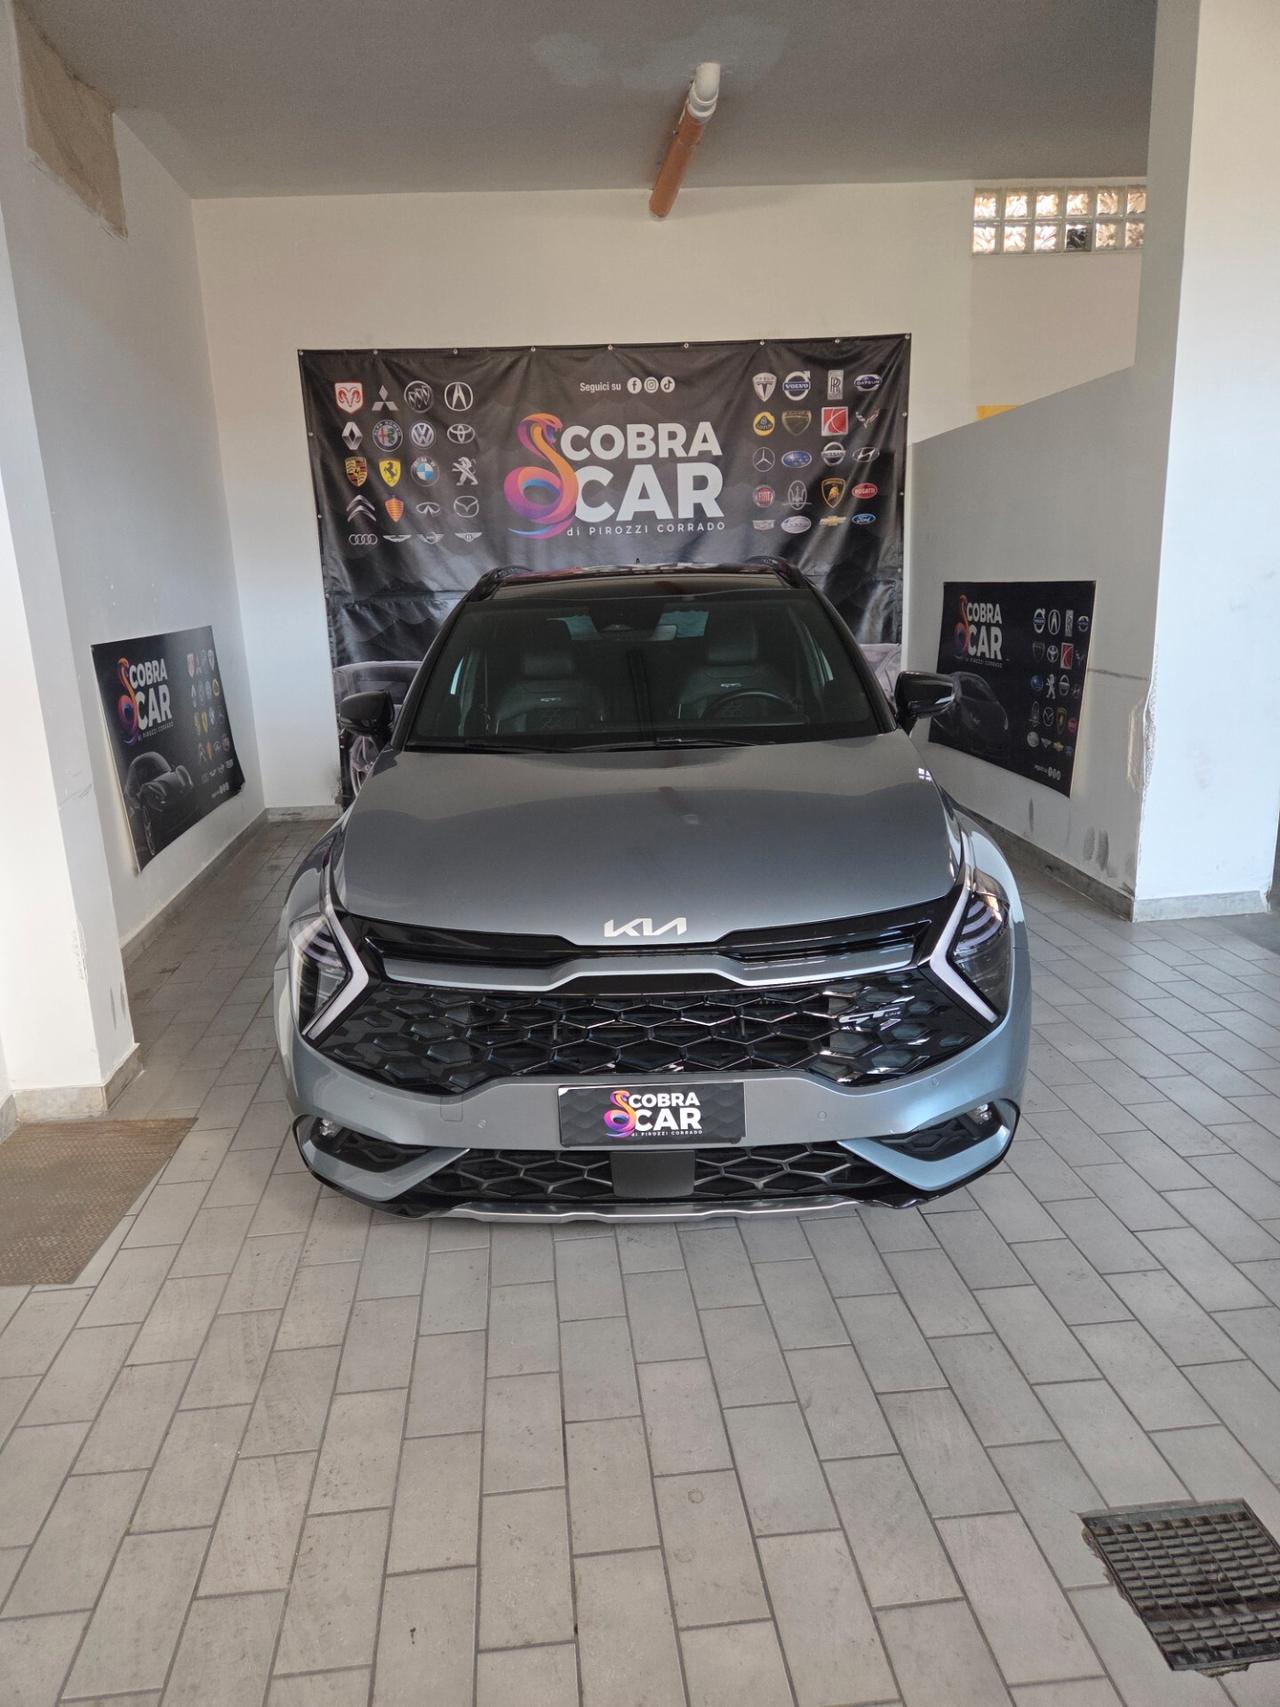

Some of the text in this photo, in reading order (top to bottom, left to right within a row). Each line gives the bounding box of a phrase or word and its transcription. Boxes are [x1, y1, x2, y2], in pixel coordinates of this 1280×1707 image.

[579, 381, 622, 393] Seguici su
[560, 421, 723, 461] COBRA
[575, 462, 725, 523] CAR
[566, 521, 725, 536] di PIROZZI CORRADO
[966, 602, 1003, 625] COBRA
[968, 624, 1003, 661] CAR
[129, 658, 168, 689] COBRA
[135, 684, 173, 731] CAR
[604, 917, 687, 937] KIA
[628, 1091, 701, 1109] COBRA
[635, 1106, 702, 1132] CAR
